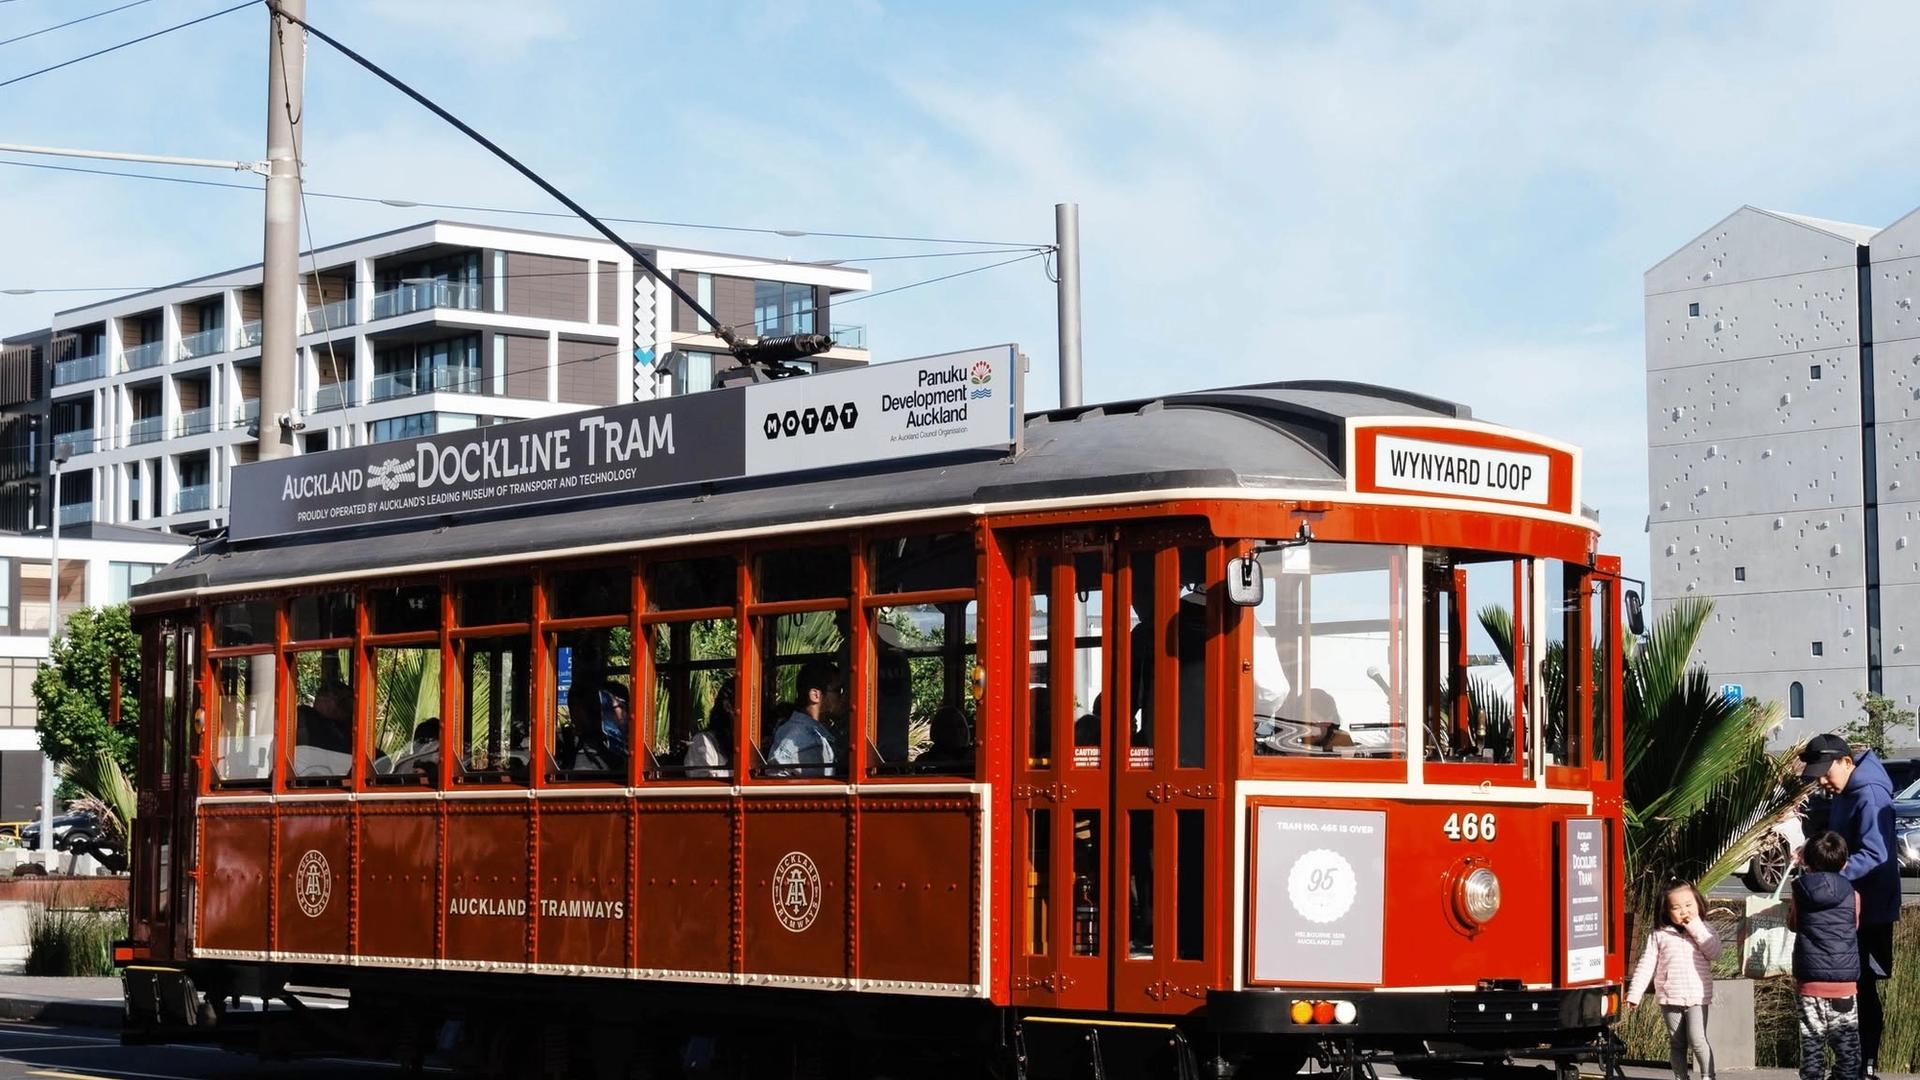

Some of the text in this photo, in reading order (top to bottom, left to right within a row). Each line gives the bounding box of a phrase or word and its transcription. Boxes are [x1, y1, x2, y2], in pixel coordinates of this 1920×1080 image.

[918, 365, 968, 387] Panuku
[882, 384, 967, 412] Development
[765, 404, 856, 437] MOTAT
[906, 403, 968, 428] Auckland
[898, 432, 919, 441] Auckland
[920, 429, 937, 439] Council
[282, 413, 675, 501] AUCKLAND DOCKLINE TRAM
[1390, 449, 1532, 491] WYNYARD LOOP
[298, 467, 638, 522] PROUDLY OPERATED BY AUCKLAND'S LEADING MUSEUM OF TRANSPORT AND TECHNOLOGY
[1074, 748, 1101, 756] CAUTION
[1276, 821, 1301, 831] TRAM
[1303, 822, 1319, 832] NO.
[1339, 824, 1348, 833] IS
[1349, 825, 1374, 834] OVER
[1443, 812, 1497, 842] 466
[775, 855, 818, 883] AUCKLAND
[1307, 868, 1338, 892] 95
[1577, 870, 1593, 886] TRAM
[449, 898, 625, 920] AUCKLAND TRAMWAYS
[776, 900, 818, 928] TRAMWAYS
